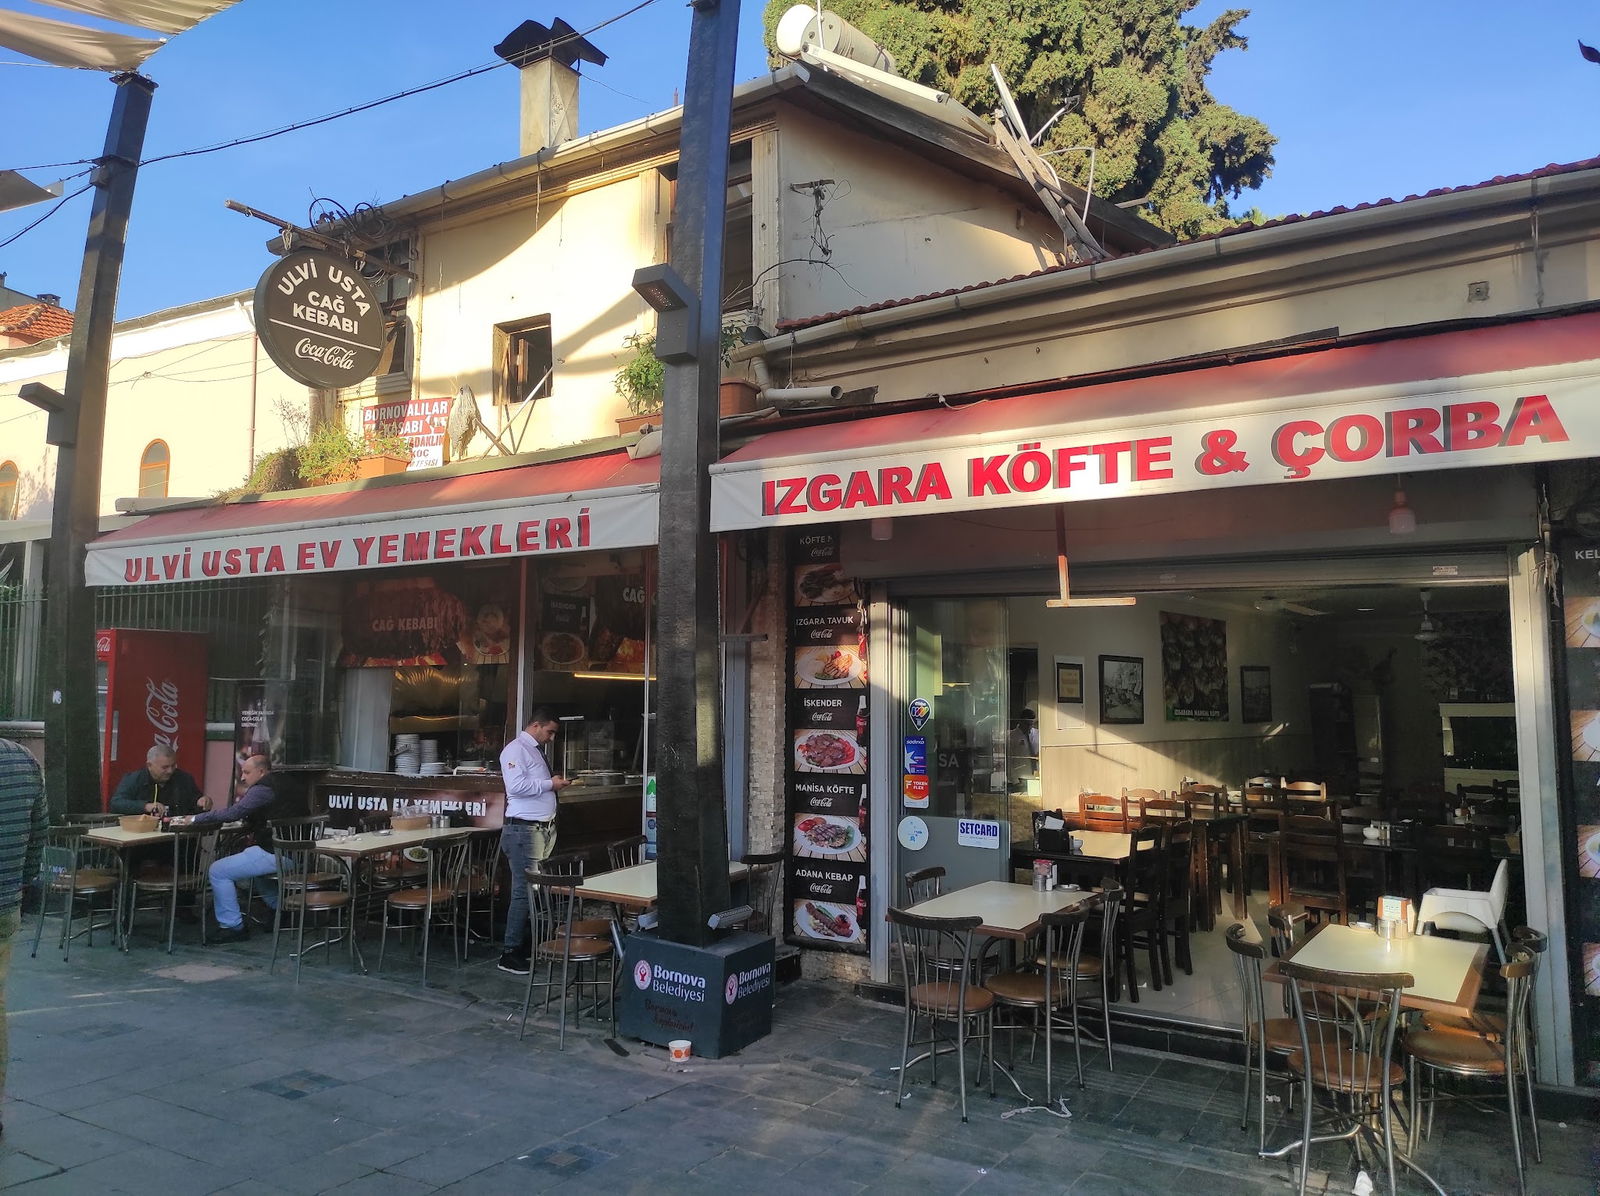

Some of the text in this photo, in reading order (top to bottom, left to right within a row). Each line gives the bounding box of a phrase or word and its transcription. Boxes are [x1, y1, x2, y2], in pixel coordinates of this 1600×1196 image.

[278, 258, 371, 317] ULVİ USTA
[307, 290, 345, 314] CAĞ
[292, 302, 359, 335] KEBABI
[294, 337, 357, 370] Coca-Cola
[364, 401, 448, 422] BORNOVALILAR
[761, 394, 1570, 516] IZGARA KÖFTE & ÇORBA
[124, 507, 590, 583] ULVİ USTA EV YEMEKLERİ
[398, 616, 438, 631] KEBABI
[796, 615, 854, 626] IZGARA TAVUK
[803, 697, 842, 707] İSKENDER
[795, 782, 855, 795] MANİSA KÖFTE
[328, 793, 353, 810] ULVİ
[358, 795, 388, 812] USTA
[960, 822, 998, 837] SETCARD
[795, 868, 854, 882] ADANA KEBAP
[653, 964, 706, 989] Bornova
[738, 962, 771, 984] Bornova
[652, 978, 705, 1003] Belediyesi
[737, 976, 771, 999] Belediyesi
